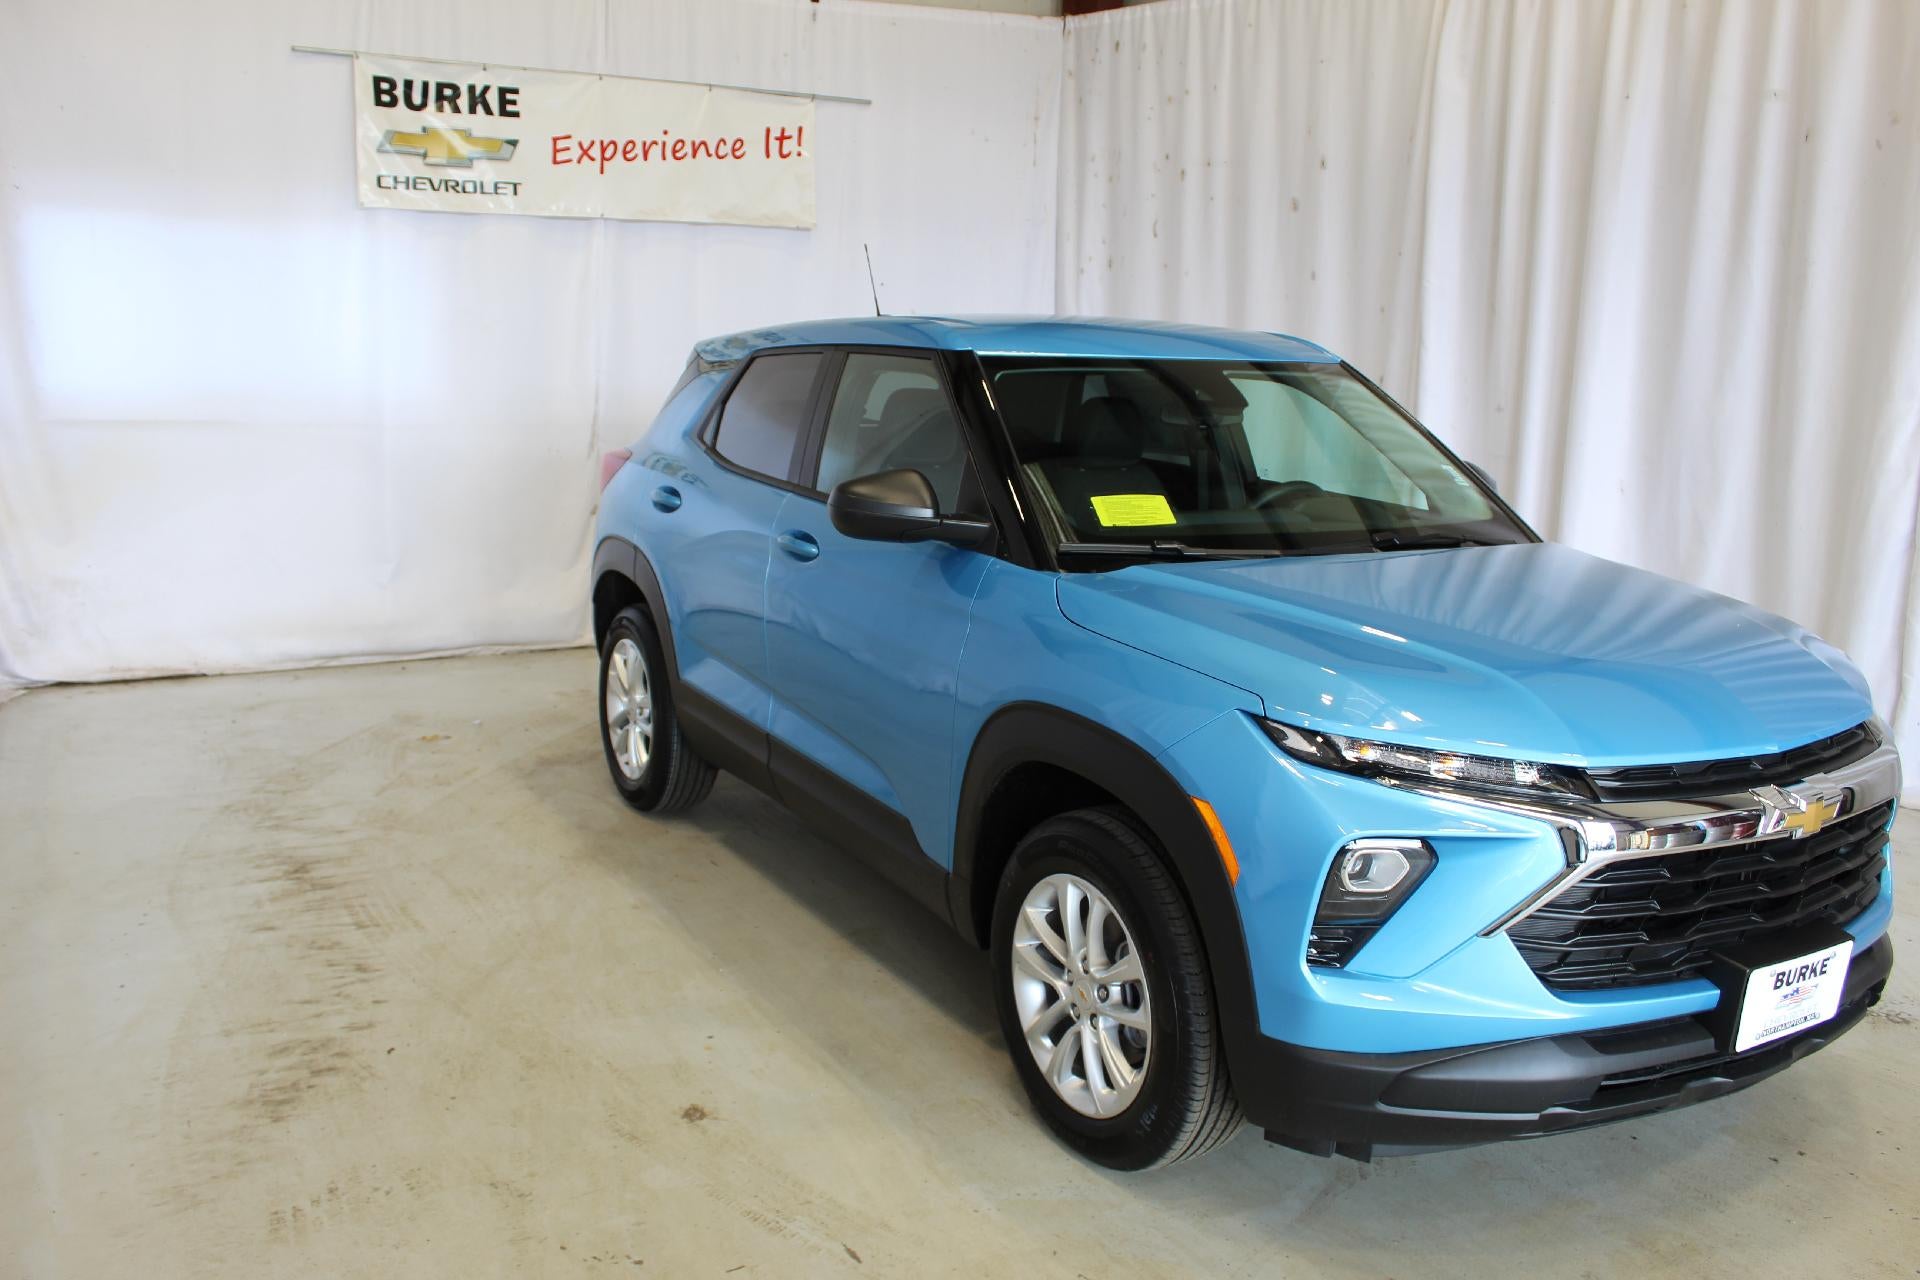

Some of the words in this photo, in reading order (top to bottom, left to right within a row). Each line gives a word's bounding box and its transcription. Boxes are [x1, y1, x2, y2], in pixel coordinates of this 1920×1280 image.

[372, 75, 521, 118] BURKE
[551, 130, 746, 175] Experience
[764, 126, 804, 159] It!
[376, 174, 522, 197] CHEVROLET
[1773, 957, 1831, 990] BURKE
